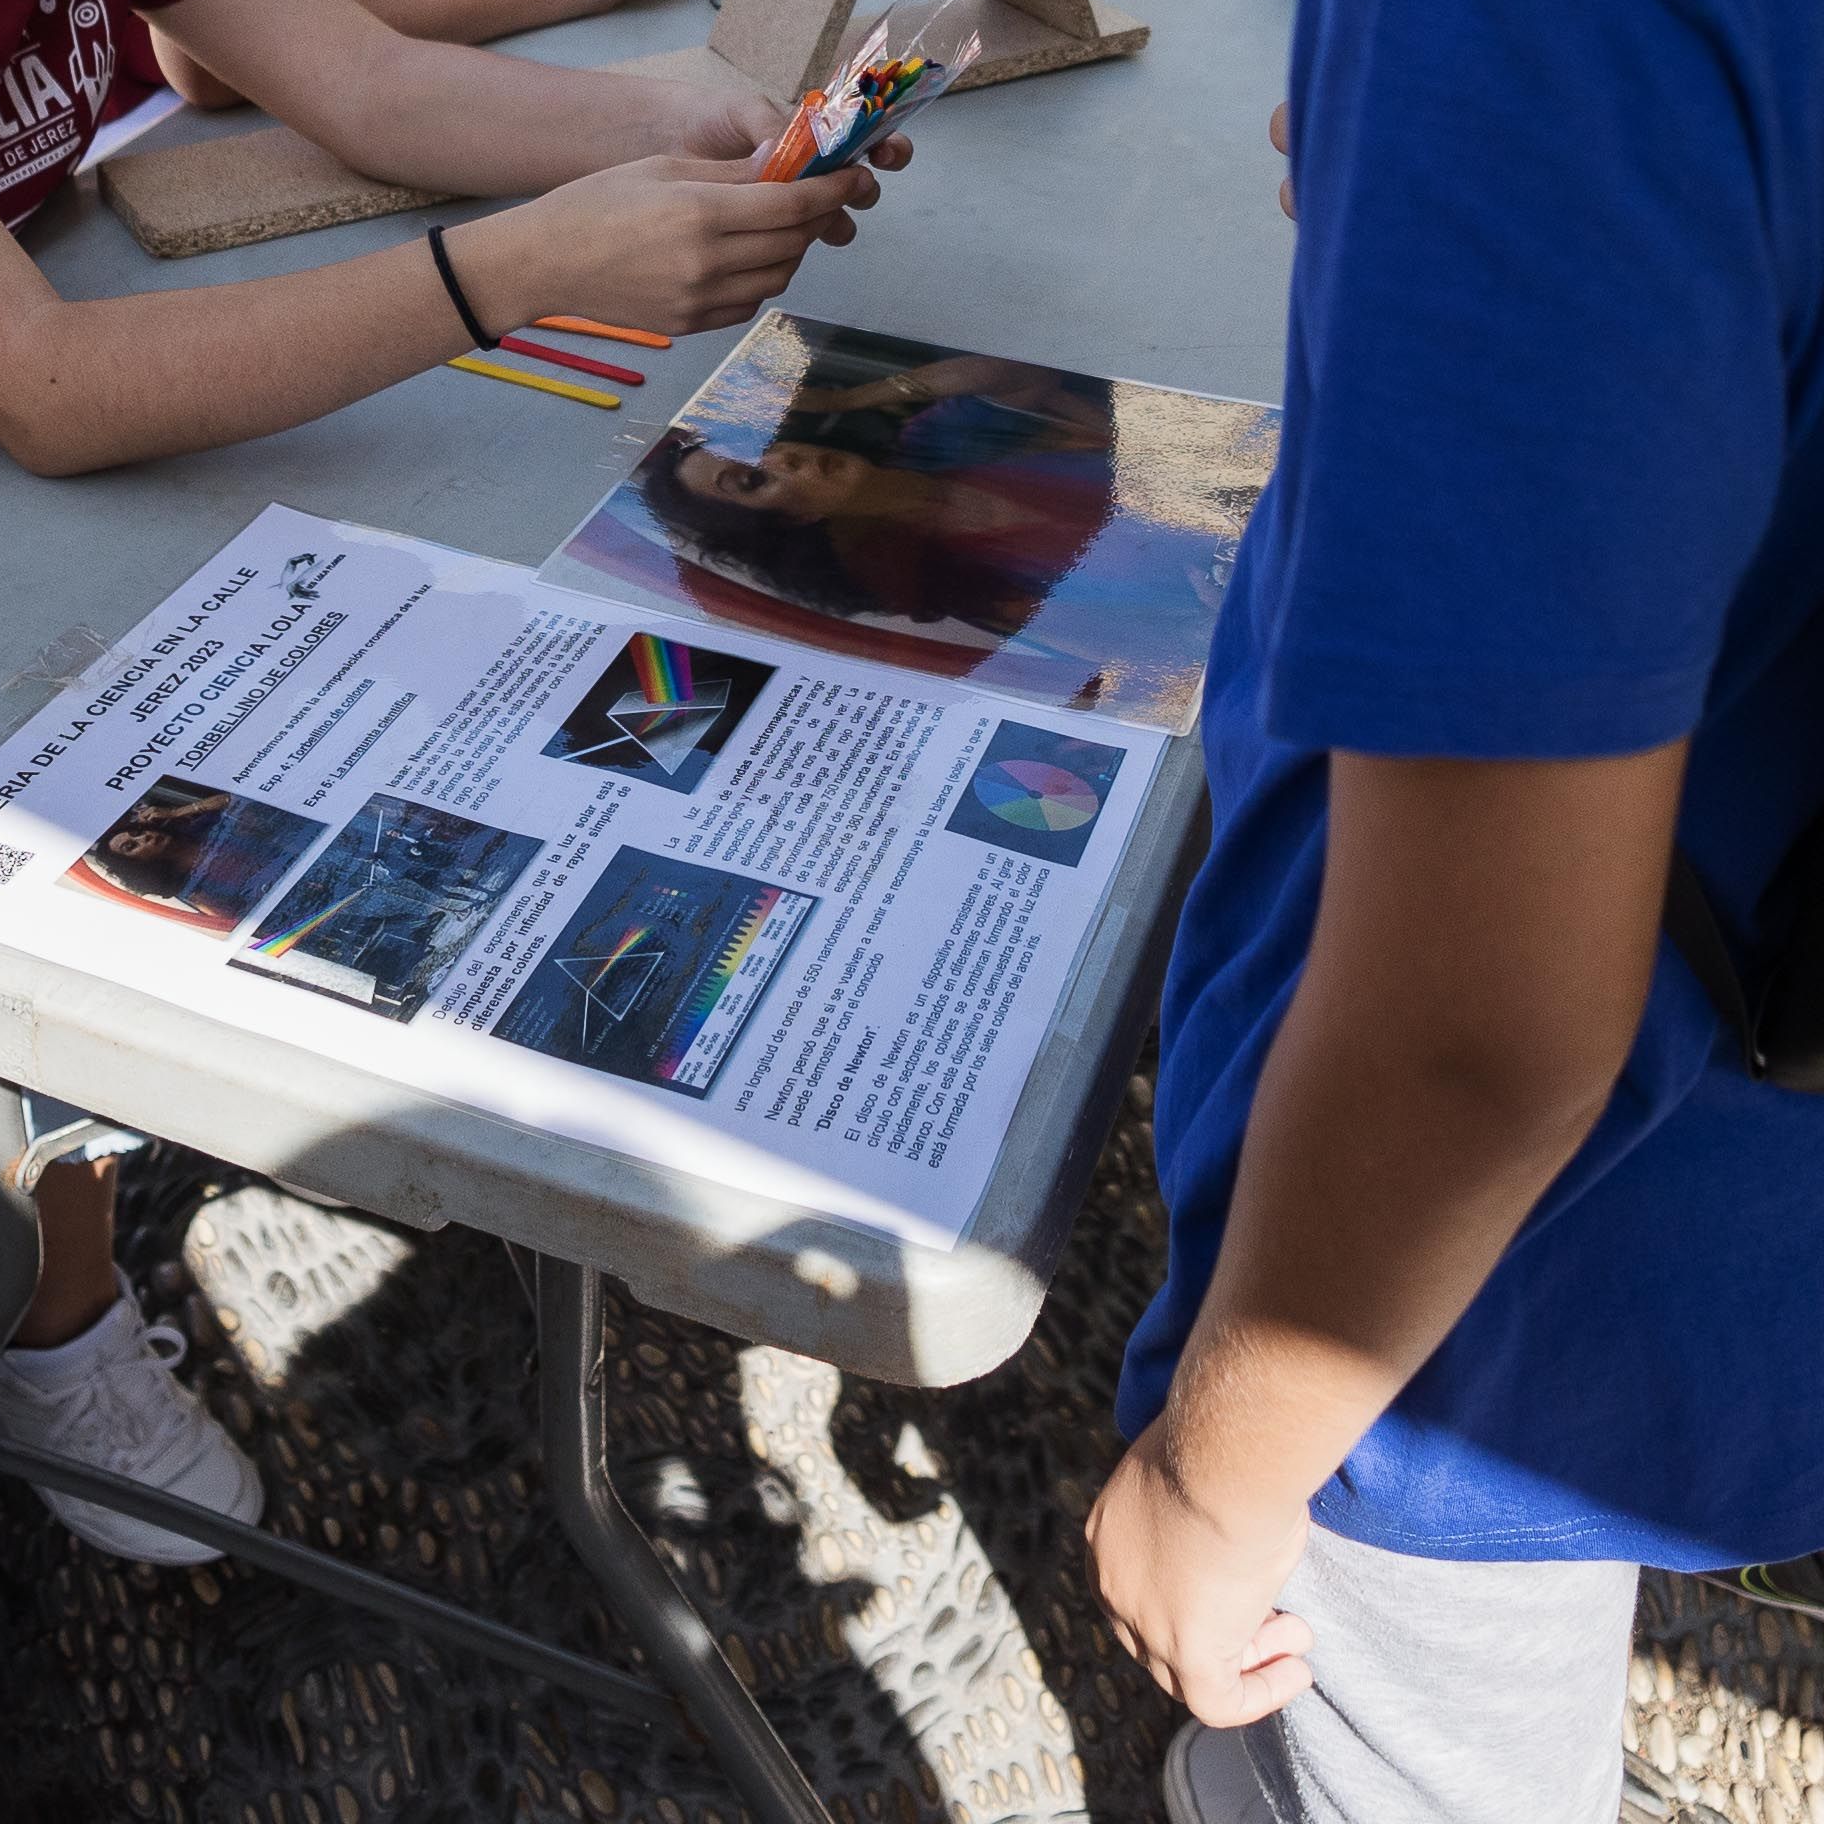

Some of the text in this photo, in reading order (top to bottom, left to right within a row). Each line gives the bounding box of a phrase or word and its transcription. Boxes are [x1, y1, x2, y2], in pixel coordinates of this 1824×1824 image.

[4, 143, 29, 168] DE
[30, 118, 78, 155] JEREZ
[27, 741, 67, 766] DE
[55, 716, 94, 741] LA
[81, 654, 161, 717] CIENCIA
[148, 632, 184, 654] EN
[173, 611, 208, 632] LA
[195, 566, 257, 611] CALLE
[103, 600, 310, 790] PROYECTO CIENCIA LOLA
[124, 638, 224, 722] JEREZ 2023
[172, 609, 343, 770] TORBELLINO DE COLORES
[227, 582, 431, 784] Aprendemos sobre la composición cromática de la luz
[255, 676, 373, 793] Exp. 4: Torbellino de colores
[300, 690, 416, 808] Exp 5: La pregunta científica
[468, 777, 501, 810] arco iris.
[681, 833, 703, 853] está
[696, 803, 723, 830] hecha
[716, 788, 733, 801] de
[726, 758, 753, 786] ondas
[746, 682, 805, 756] electromagnéticas
[429, 779, 616, 1020] Dedujo del experimento, que la luz solar está
[448, 784, 633, 1026] compuesta por infinidad de rayos simples de
[467, 975, 516, 1031] diferentes
[507, 931, 547, 975] colores.
[923, 931, 1042, 1169] está formada por los siete colores del arco iris.
[811, 1022, 879, 1133] "Disco de Newton".
